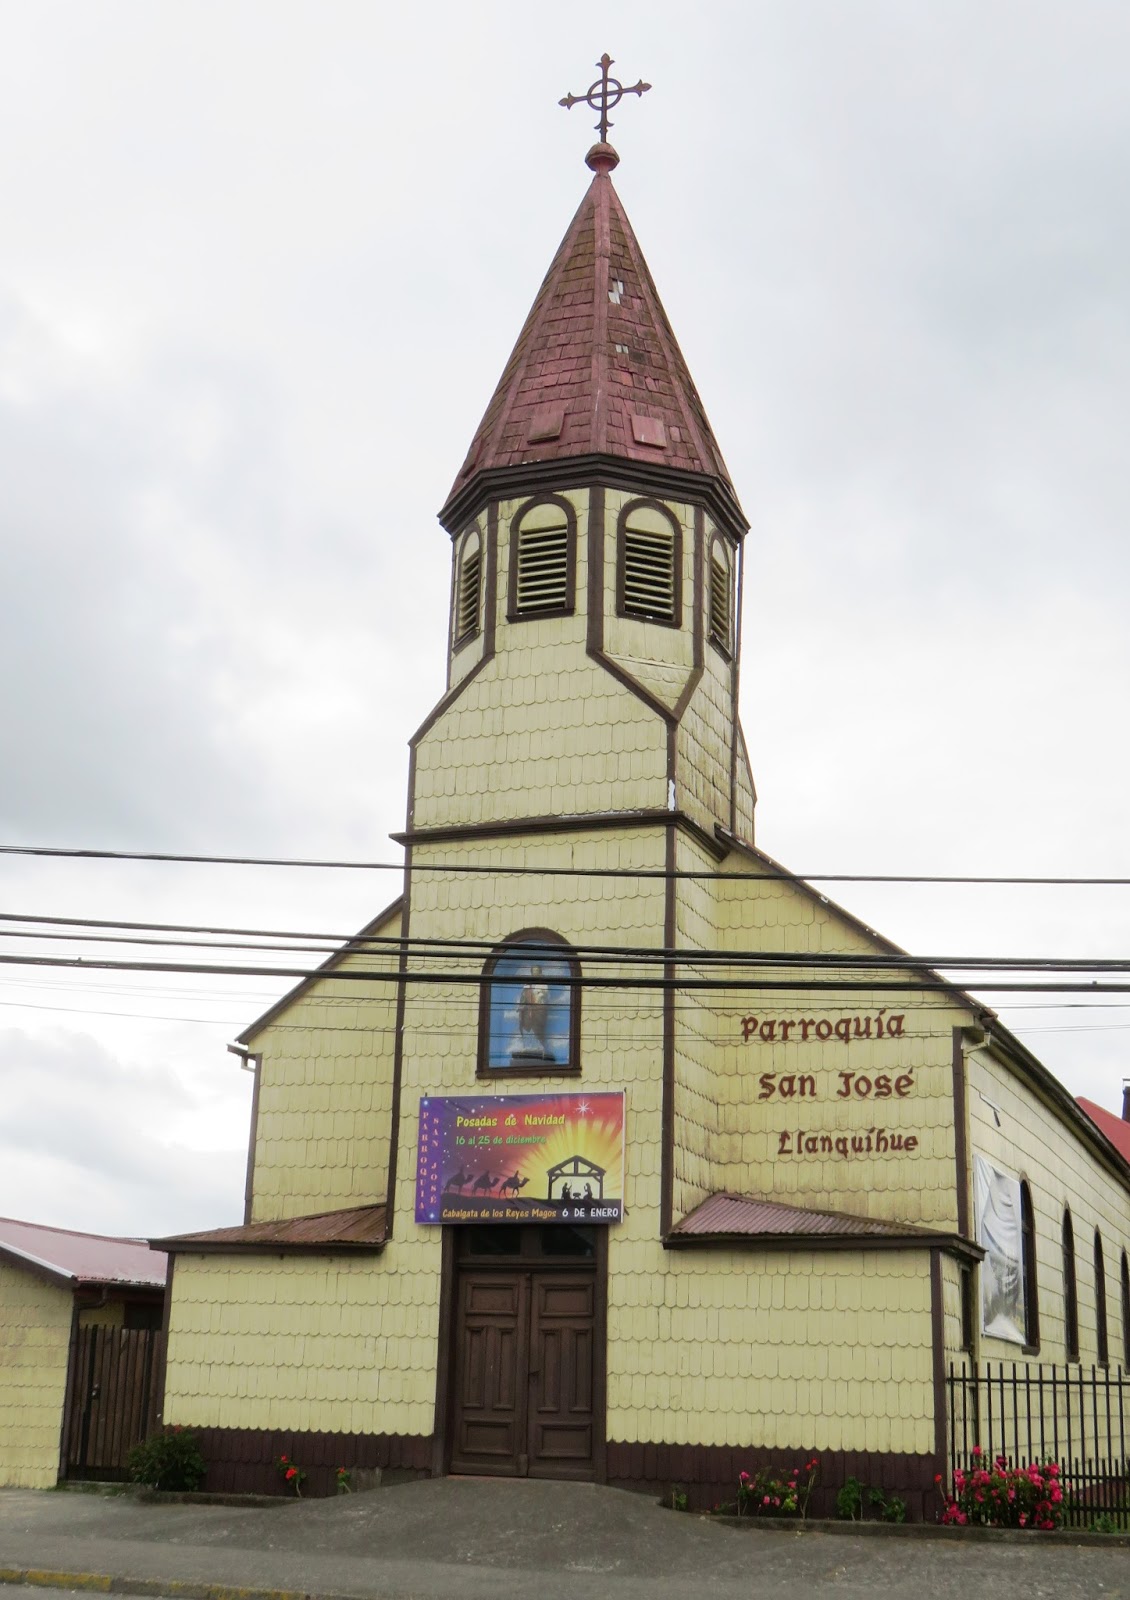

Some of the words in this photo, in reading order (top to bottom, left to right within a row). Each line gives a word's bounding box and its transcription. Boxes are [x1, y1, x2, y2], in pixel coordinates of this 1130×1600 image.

[758, 1073, 817, 1099] San
[836, 1067, 914, 1098] José
[456, 1115, 498, 1127] Posadas
[504, 1115, 517, 1126] de
[524, 1114, 565, 1125] Navidad
[456, 1136, 466, 1145] 16
[468, 1136, 476, 1145] al
[478, 1135, 490, 1145] 25
[493, 1136, 503, 1145] de
[506, 1134, 546, 1144] diciembre
[419, 1111, 429, 1209] PARROQUIA
[430, 1162, 438, 1204] JOSÉ
[442, 1208, 478, 1219] Cabalgata
[480, 1209, 490, 1218] de
[492, 1208, 504, 1218] los
[506, 1208, 529, 1219] Reyes
[531, 1208, 557, 1219] Magos
[562, 1208, 569, 1217] 6
[574, 1207, 585, 1217] DE
[590, 1207, 619, 1217] ENERO
